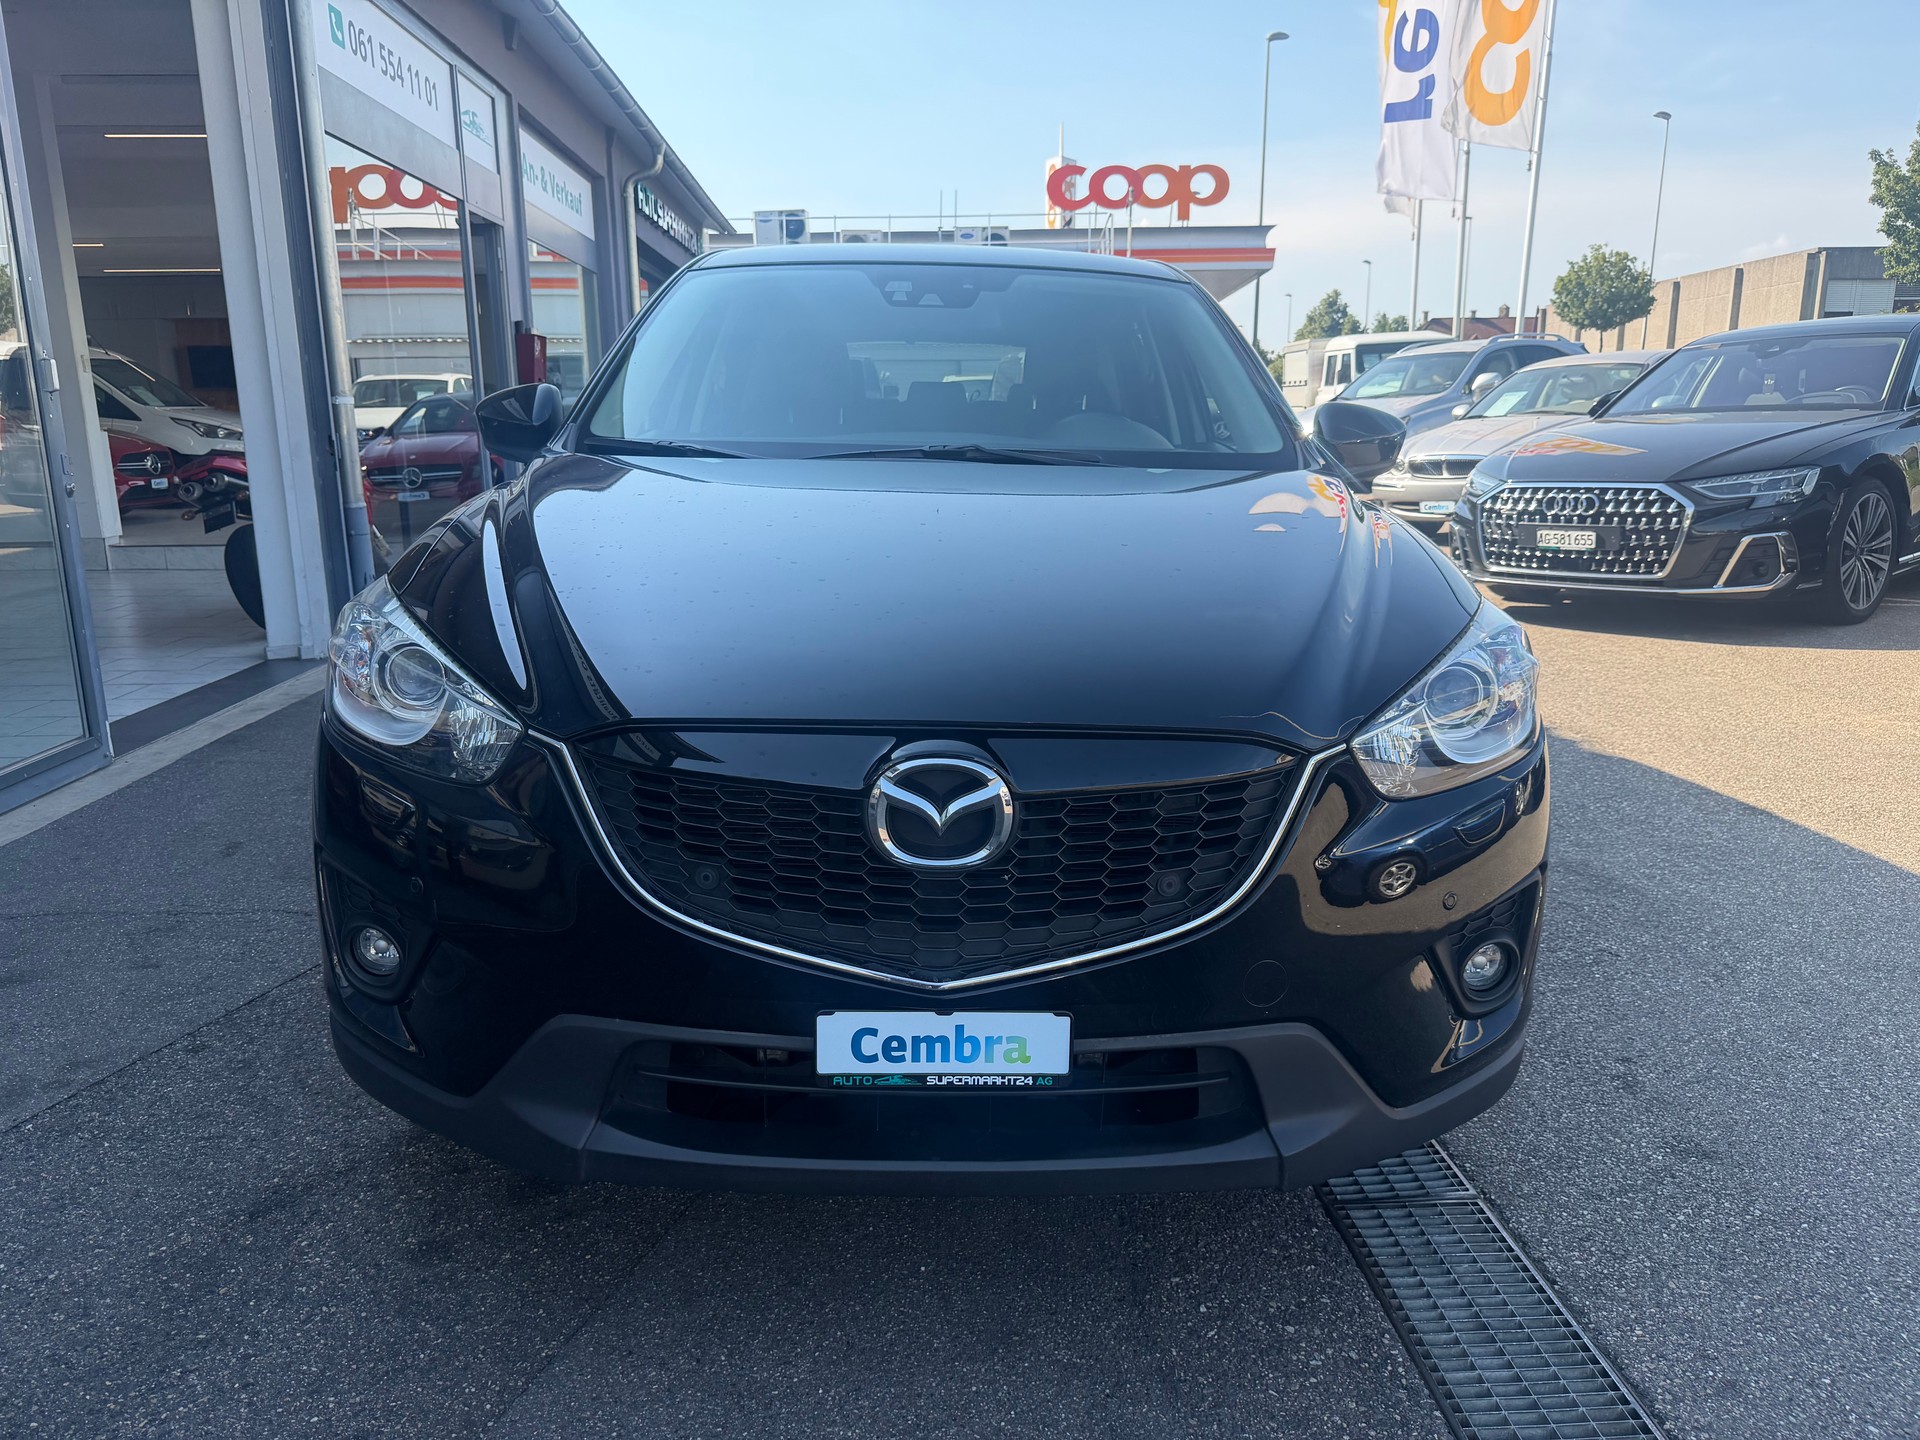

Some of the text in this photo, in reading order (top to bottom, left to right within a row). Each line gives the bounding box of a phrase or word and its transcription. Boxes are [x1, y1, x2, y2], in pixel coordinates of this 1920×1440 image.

[347, 19, 439, 112] 061 554 11 01
[521, 151, 583, 217] An- & Verkauf
[1046, 163, 1230, 221] coop
[1423, 503, 1449, 511] Cembra
[850, 1023, 1032, 1064] Cembra
[833, 1075, 1053, 1086] AUTO SUPERMARKT24 AG
